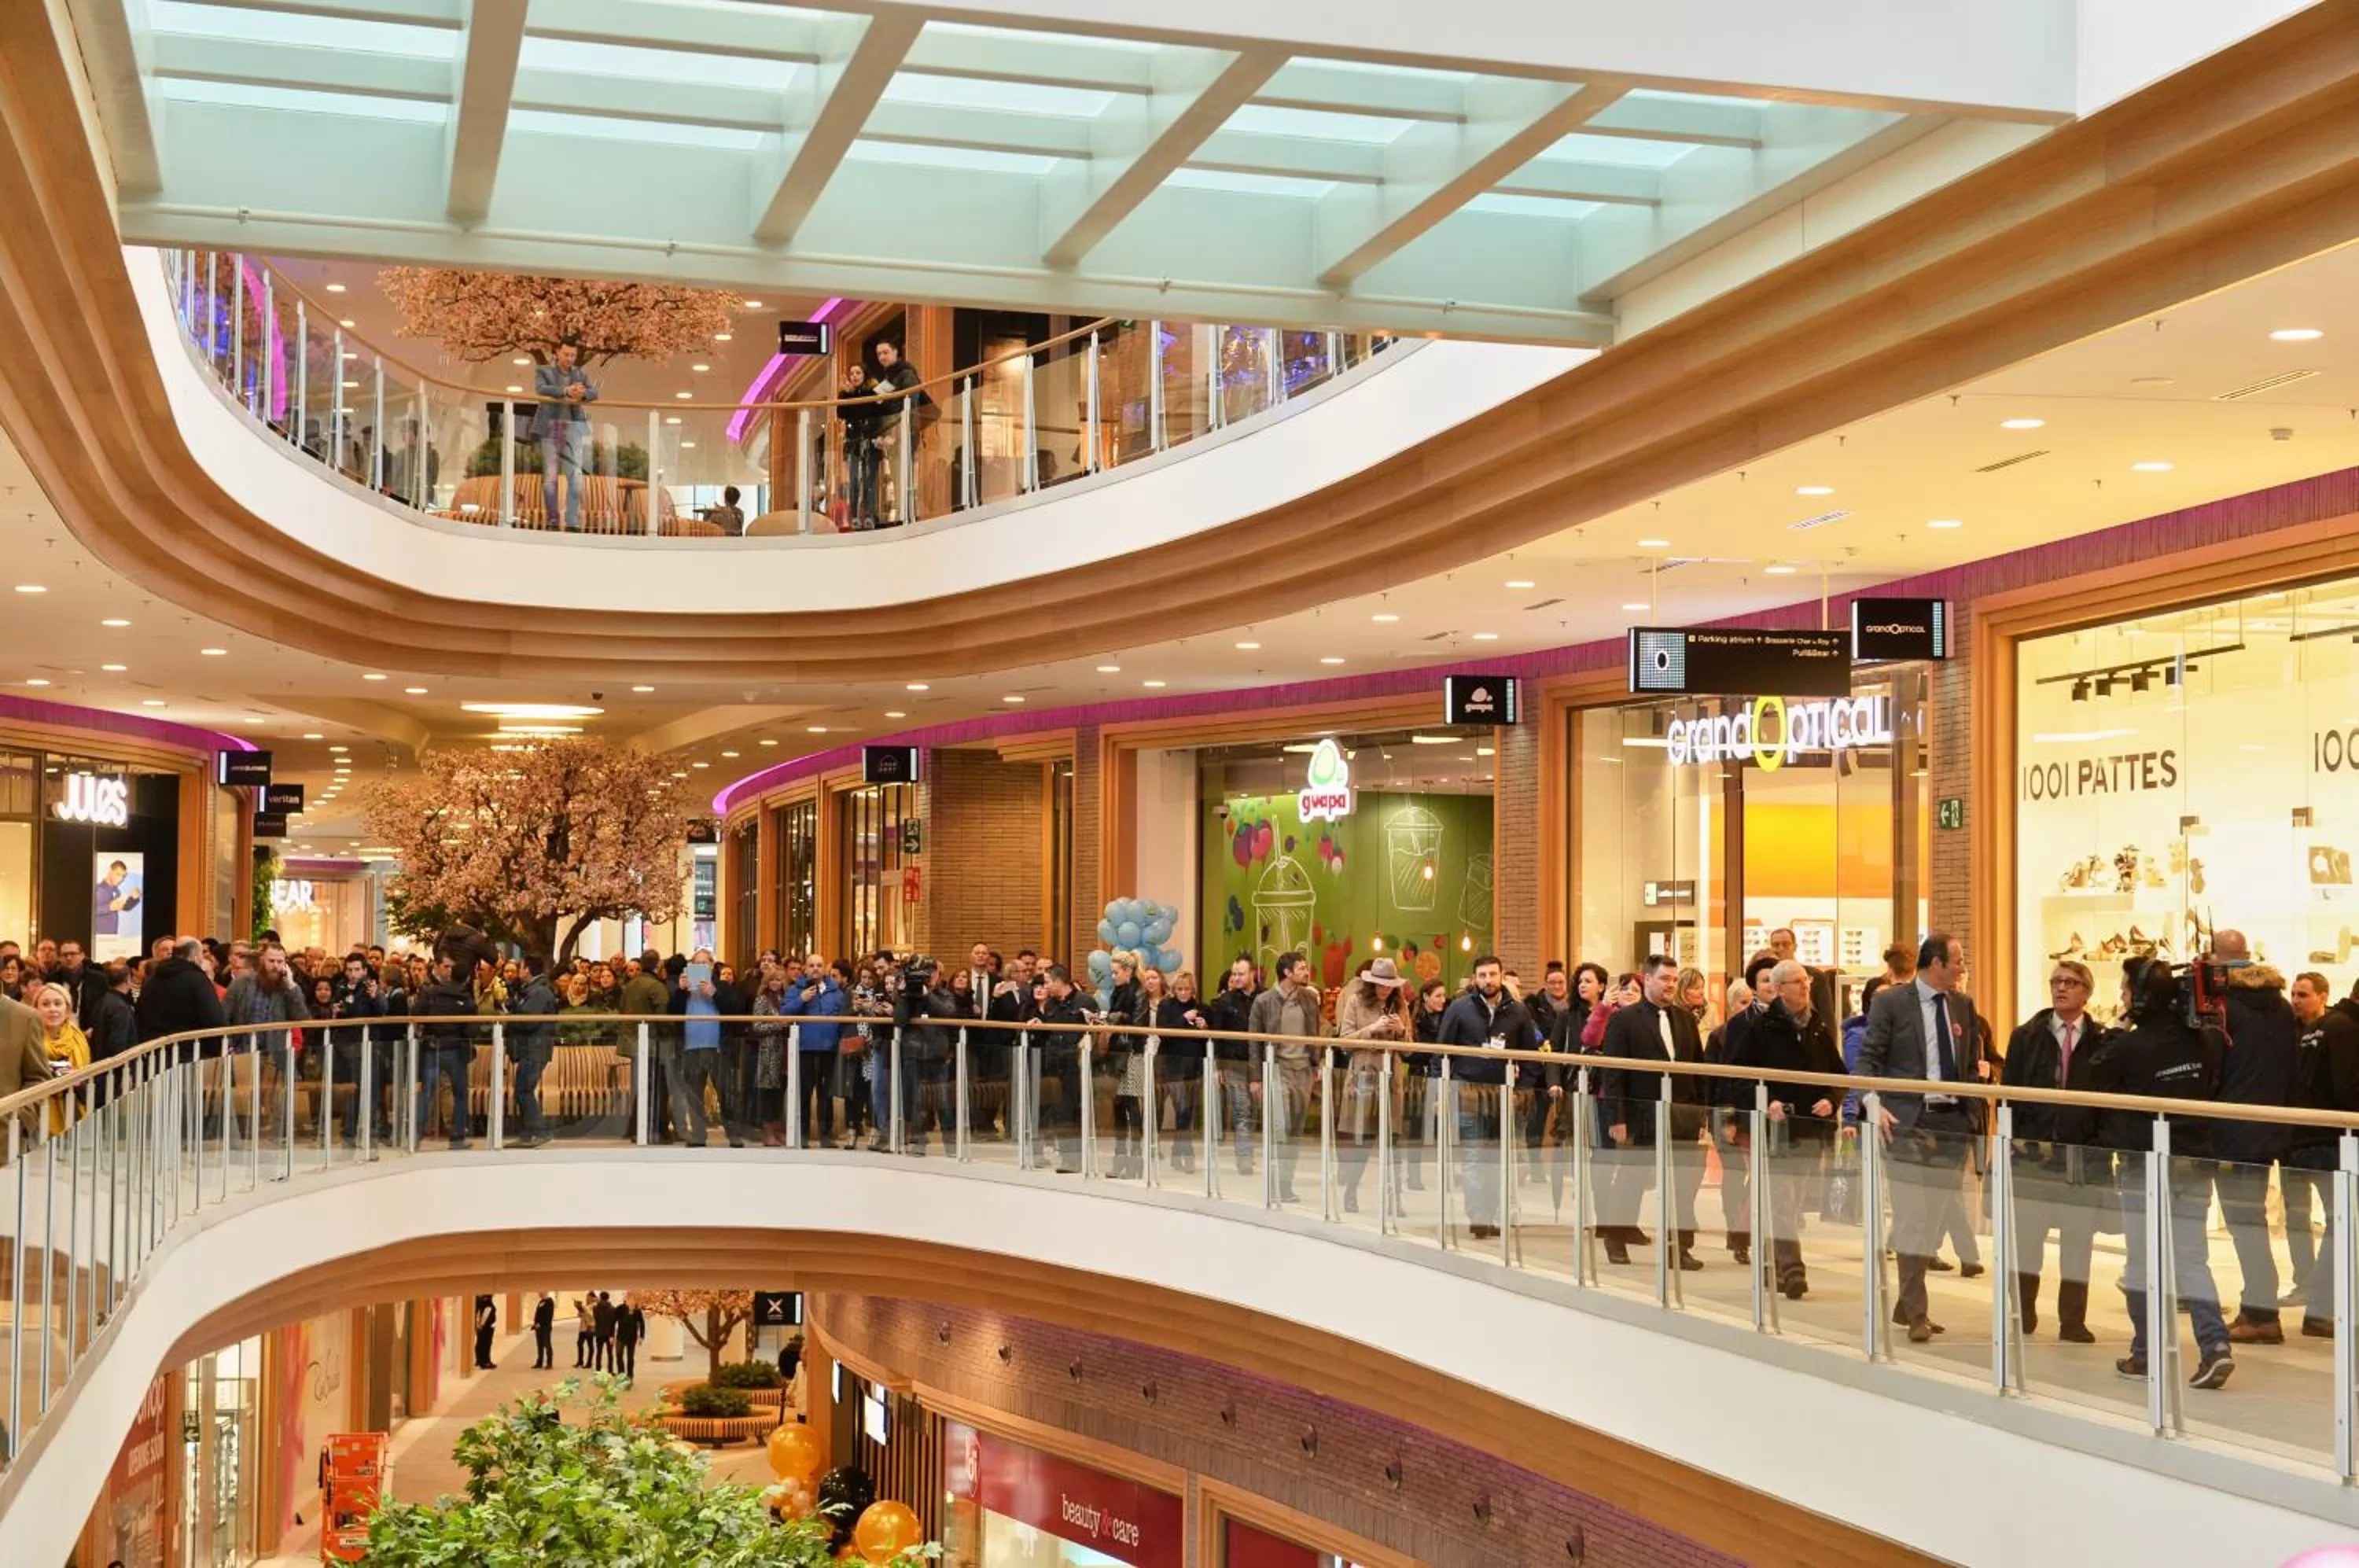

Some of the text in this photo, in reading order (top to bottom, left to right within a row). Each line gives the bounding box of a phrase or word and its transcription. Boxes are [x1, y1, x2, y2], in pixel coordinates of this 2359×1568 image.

[1698, 635, 1728, 644] Parking
[1465, 704, 1493, 713] guapa
[2078, 749, 2177, 796] PATTES
[1301, 793, 1346, 816] guapa
[1062, 1493, 1101, 1538] beauty
[1113, 1518, 1139, 1548] care
